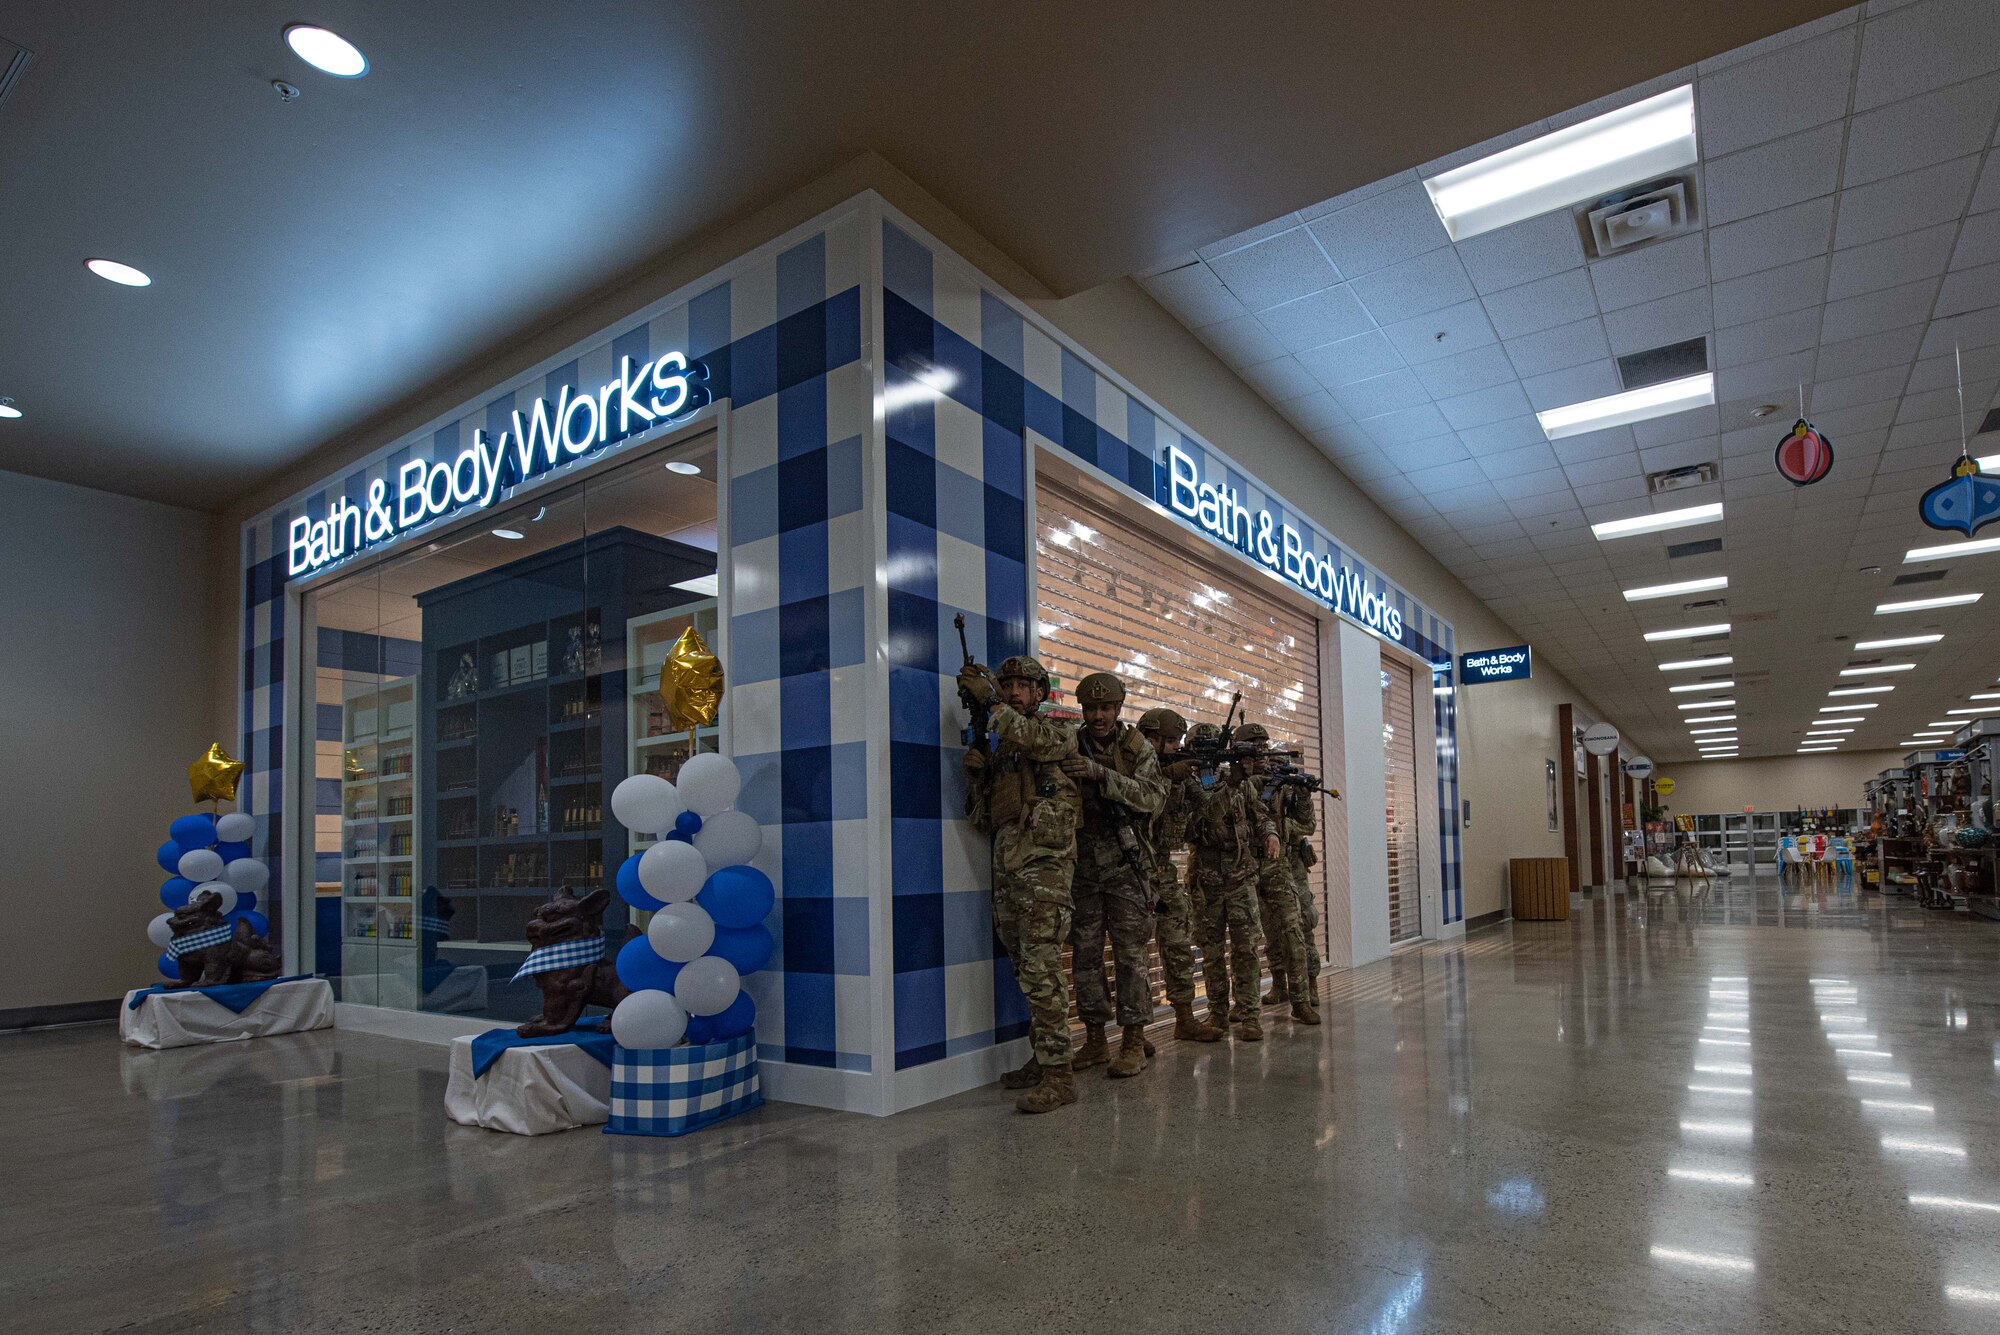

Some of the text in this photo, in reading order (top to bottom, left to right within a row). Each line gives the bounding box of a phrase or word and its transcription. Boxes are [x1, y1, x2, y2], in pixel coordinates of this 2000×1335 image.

[289, 351, 688, 576] Bath & Body Works
[1169, 444, 1402, 641] Bath & Body Works
[1466, 656, 1489, 668] Bath
[1490, 655, 1498, 665] &
[1499, 652, 1526, 664] Body
[1480, 665, 1513, 676] Works
